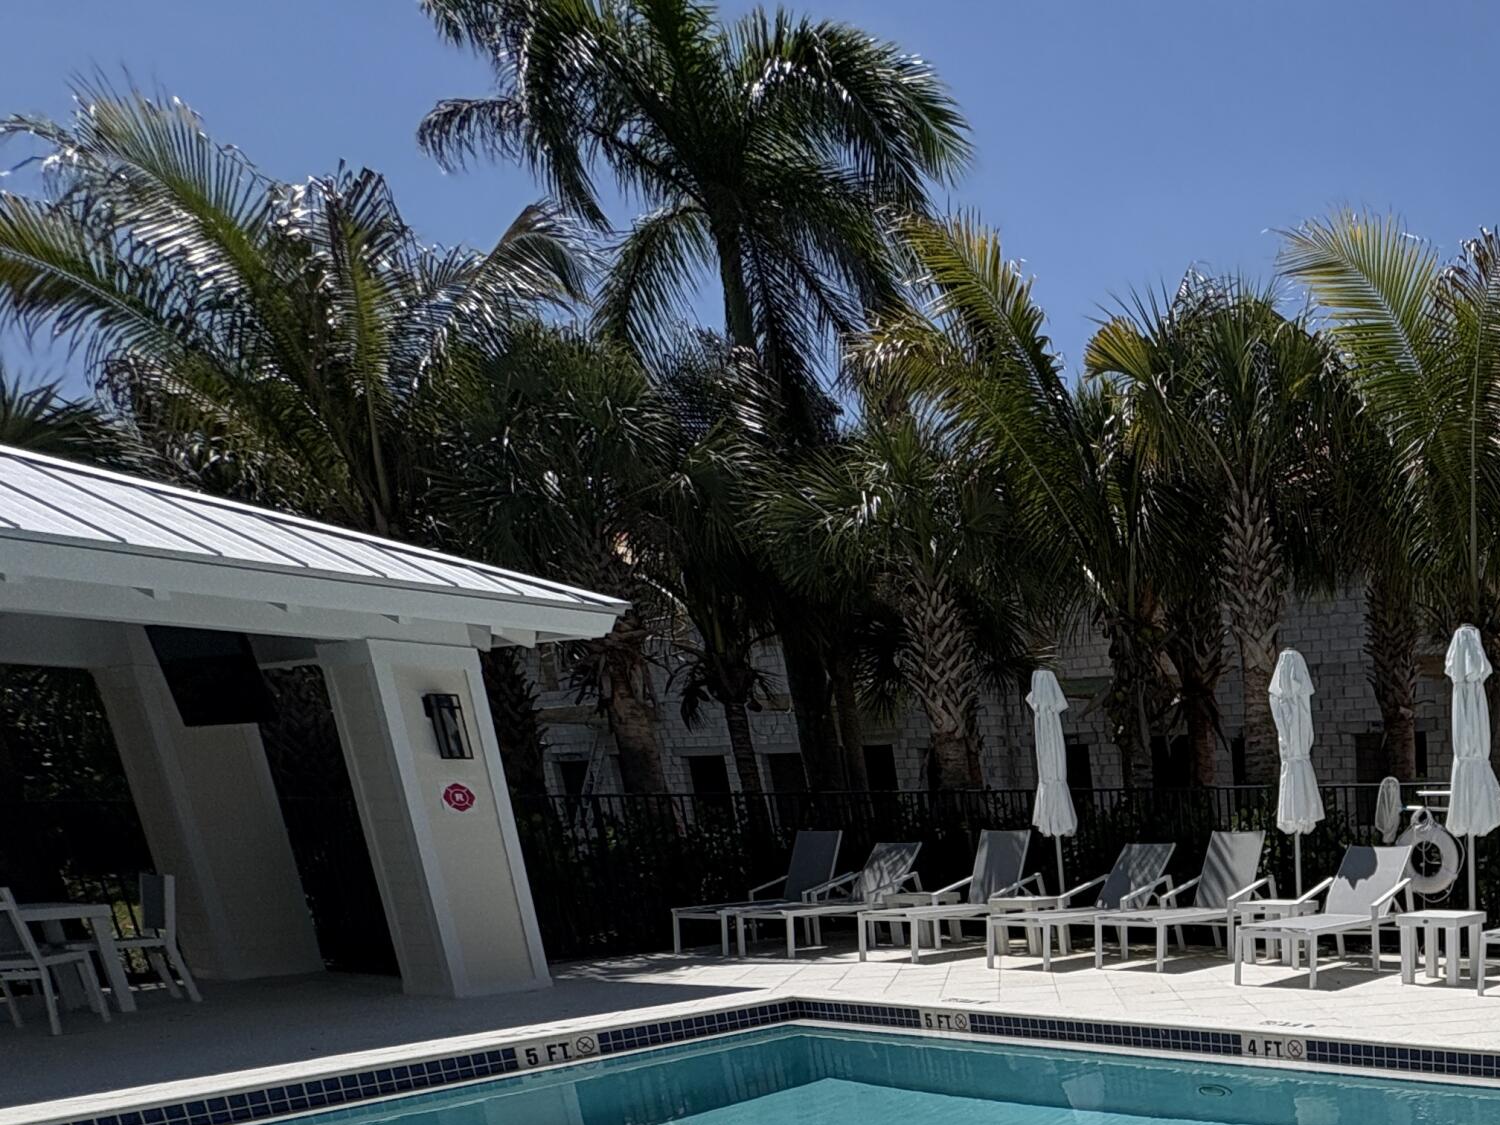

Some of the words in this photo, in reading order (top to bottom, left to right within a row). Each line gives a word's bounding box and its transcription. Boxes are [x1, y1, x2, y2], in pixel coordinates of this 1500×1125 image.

[924, 1013, 933, 1028] 5
[1248, 1039, 1258, 1055] 4
[525, 1047, 539, 1066] 5
